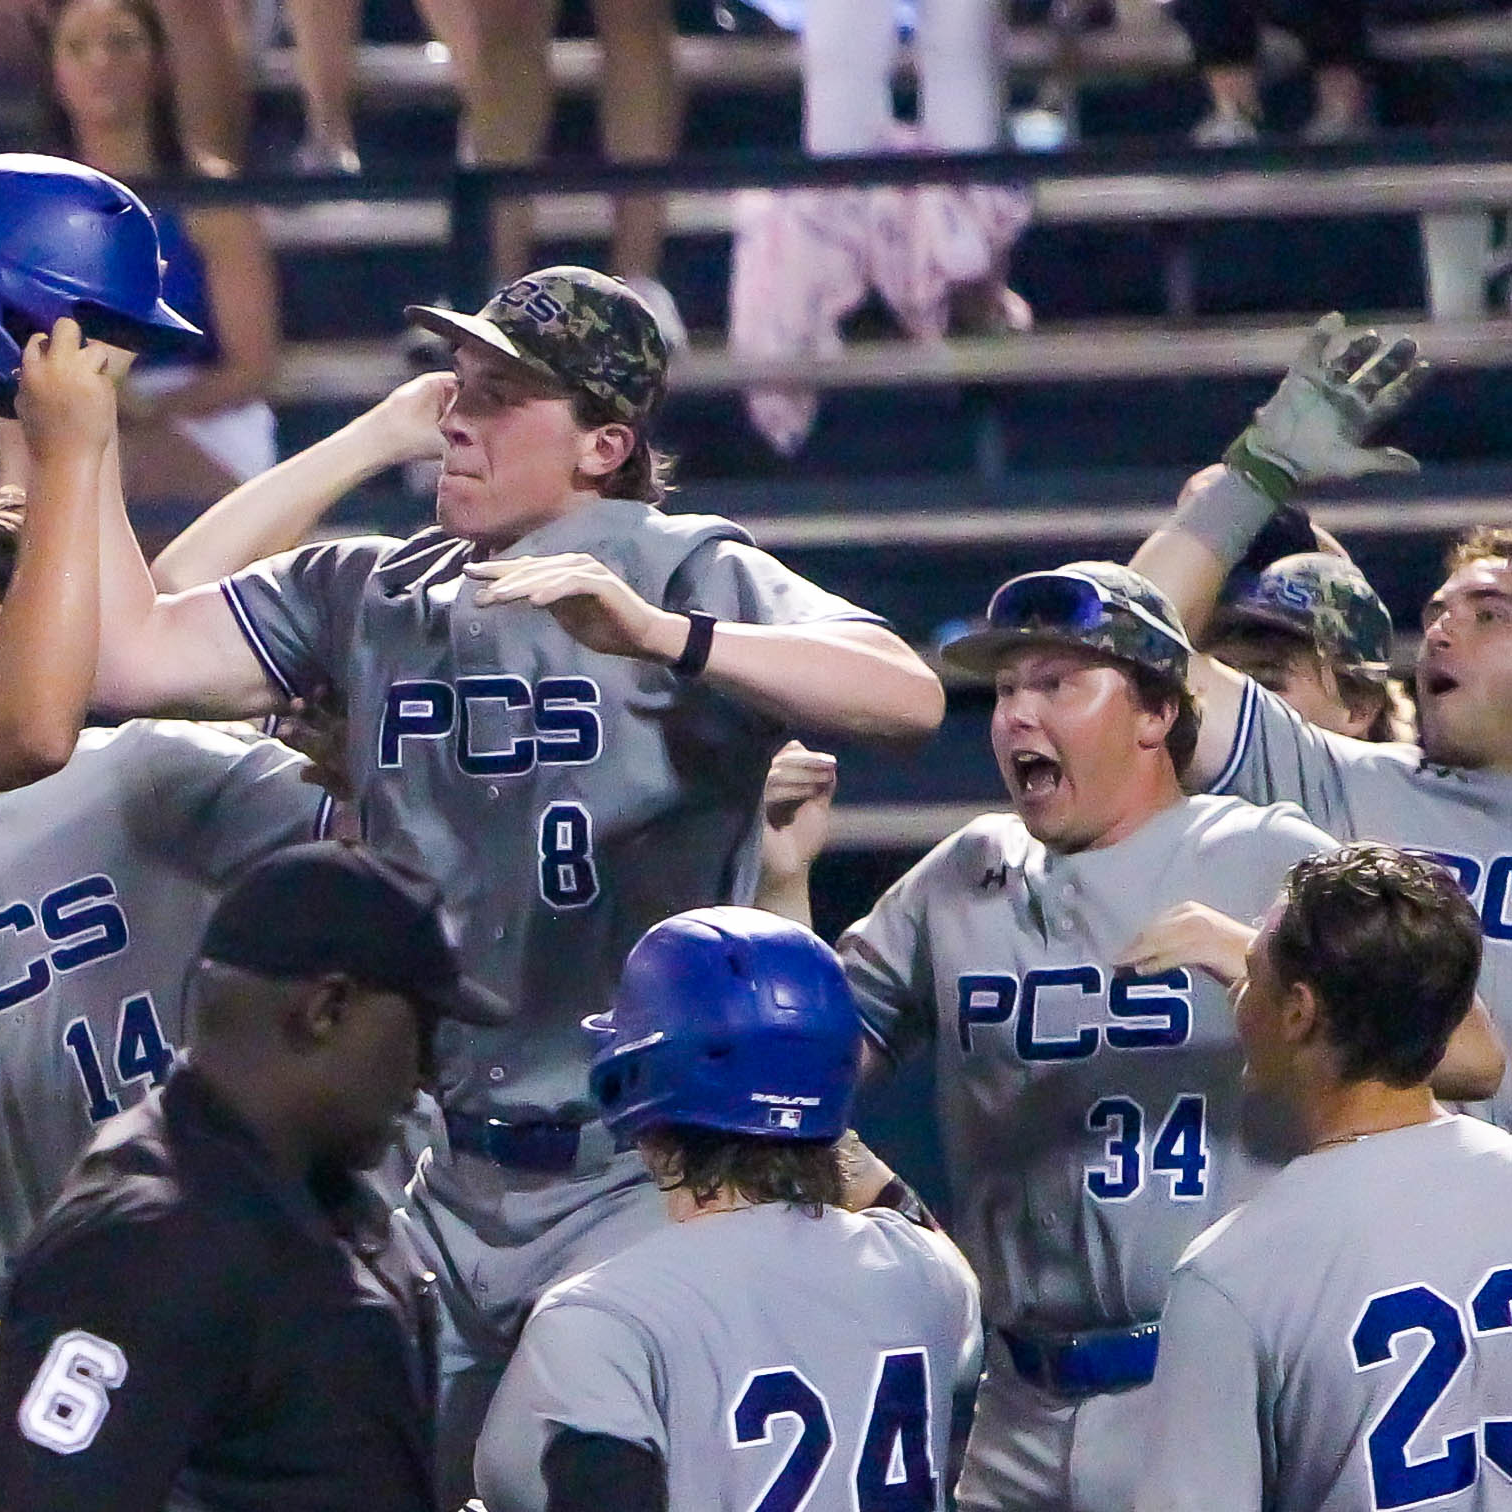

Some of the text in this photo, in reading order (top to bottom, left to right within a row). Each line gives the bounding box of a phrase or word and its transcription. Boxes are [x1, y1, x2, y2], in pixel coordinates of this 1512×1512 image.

[378, 672, 604, 779] PCS
[537, 800, 602, 910] 8
[64, 990, 176, 1124] 14
[957, 965, 1193, 1062] PCS
[1084, 1094, 1210, 1204] 34
[17, 1328, 130, 1457] 6
